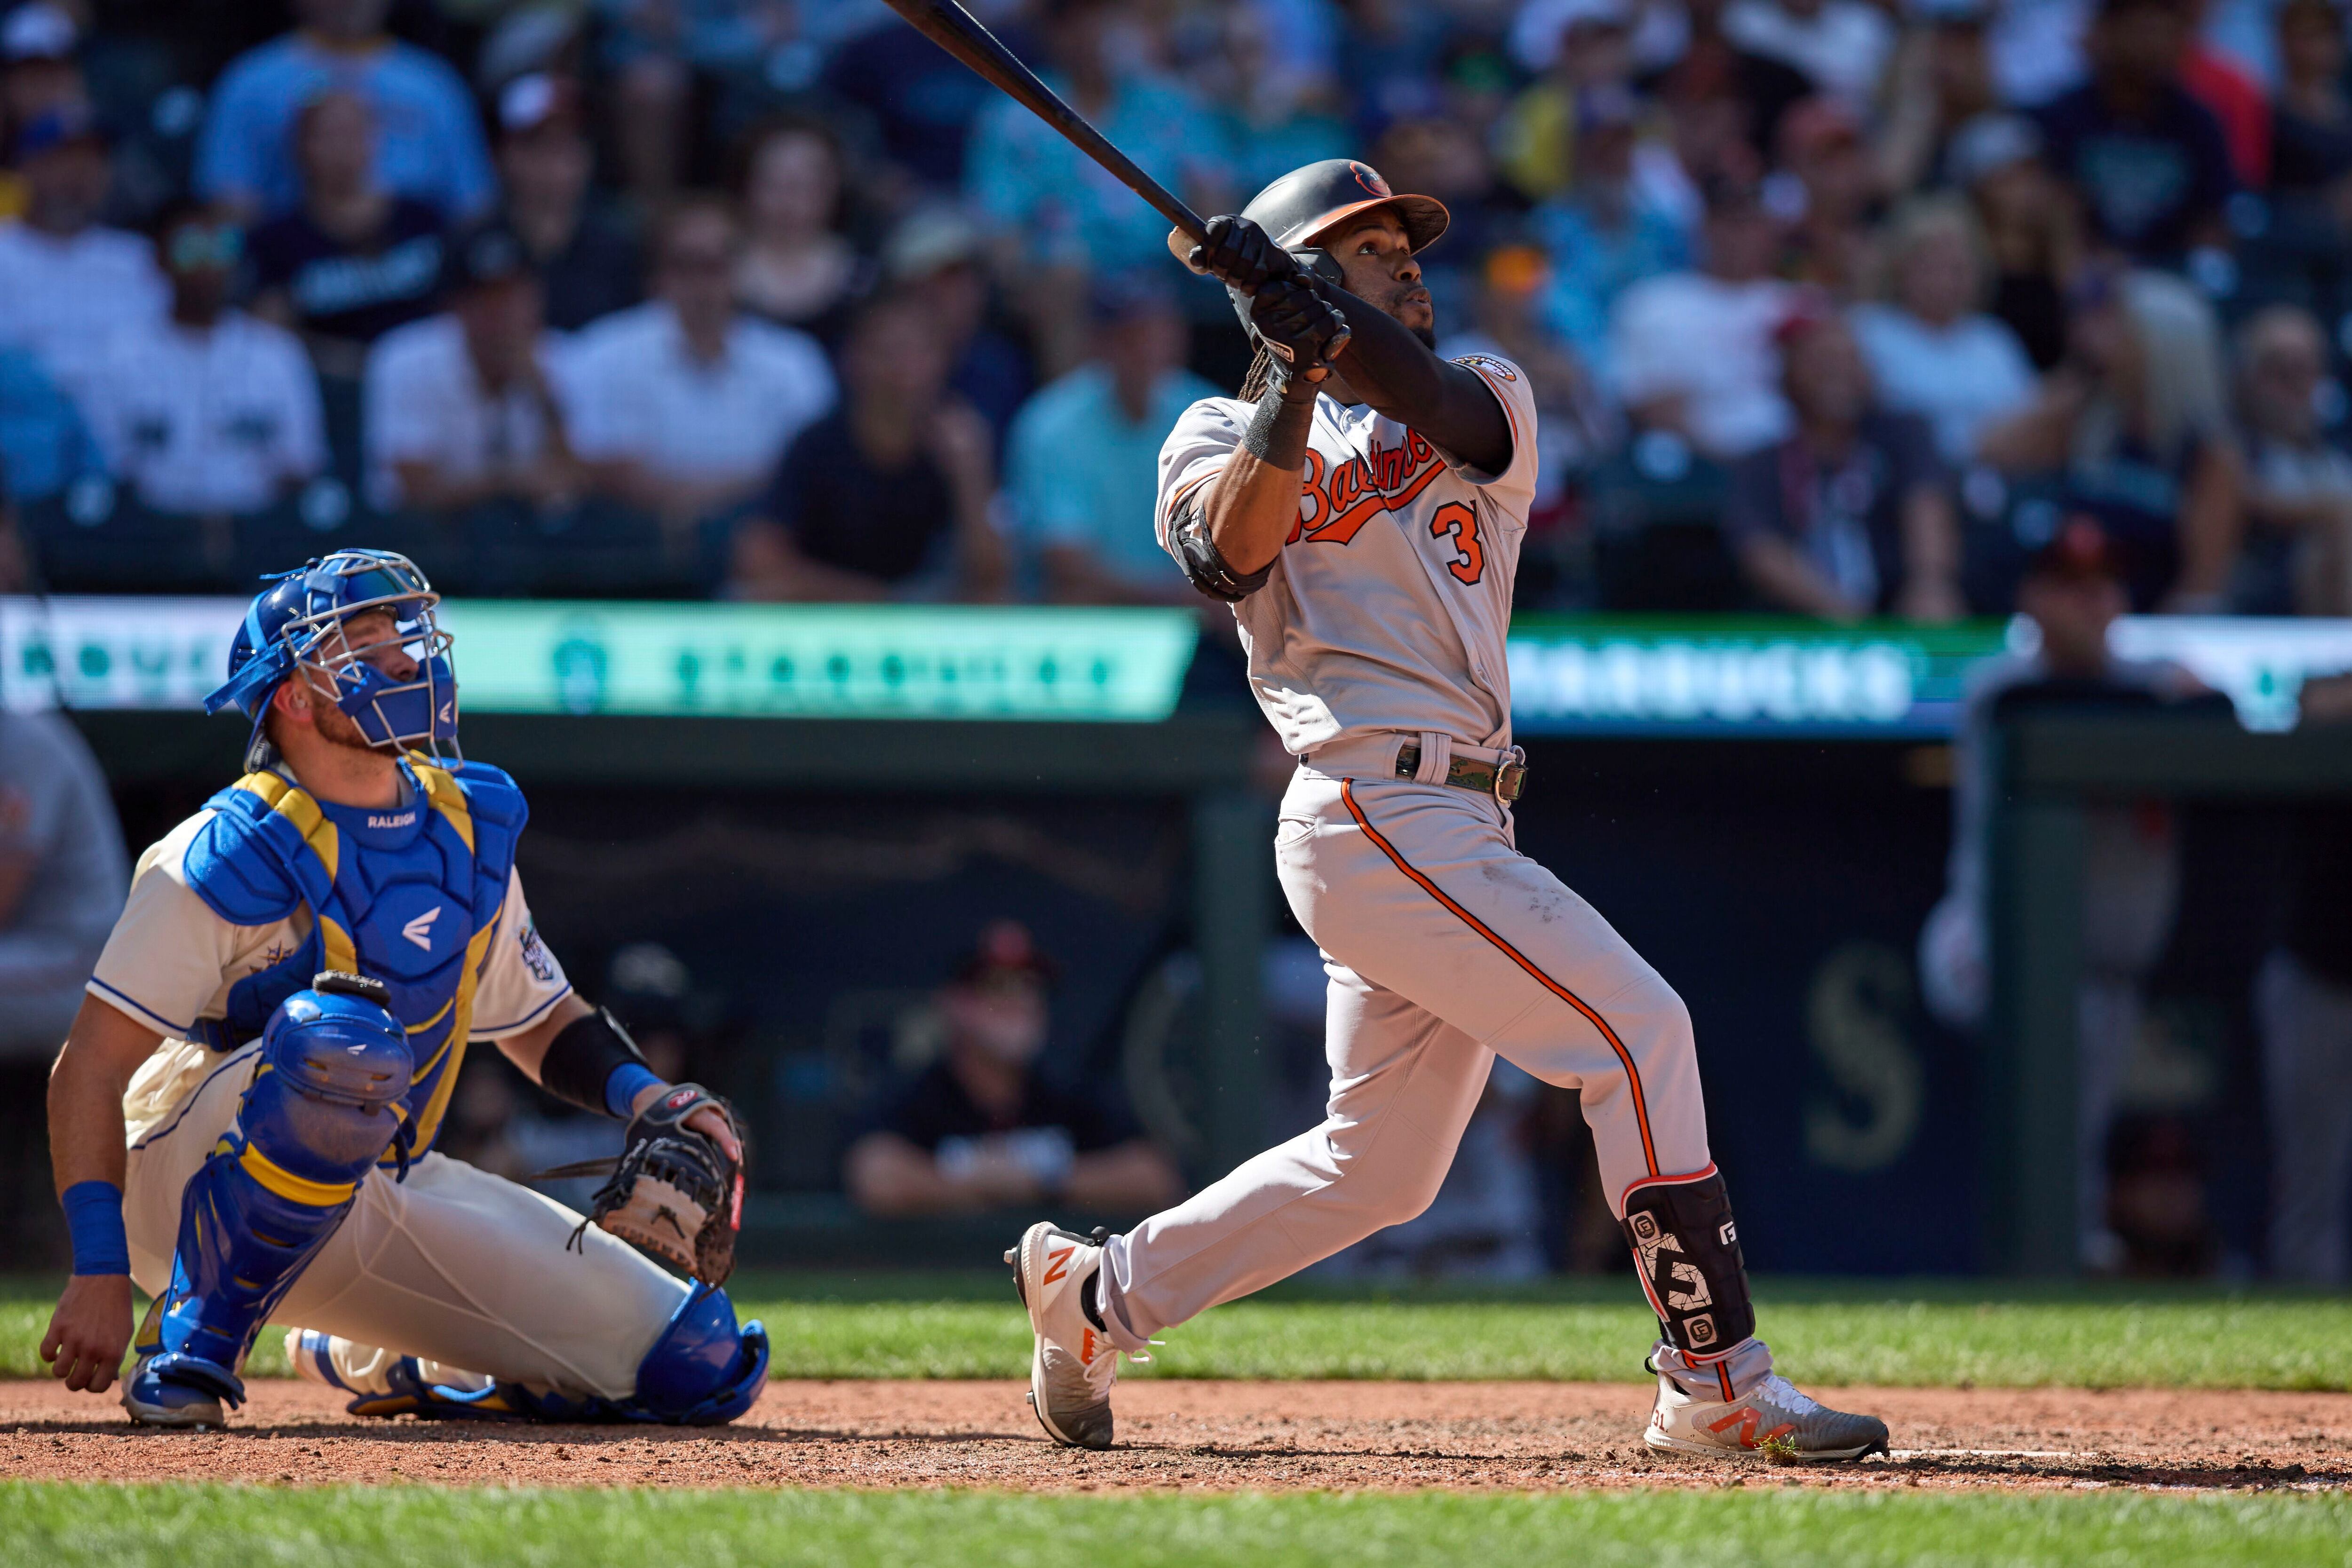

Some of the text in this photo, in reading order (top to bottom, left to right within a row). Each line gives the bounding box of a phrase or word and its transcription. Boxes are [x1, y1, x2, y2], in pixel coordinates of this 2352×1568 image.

[1453, 356, 1515, 376] ALTIMORE
[1286, 428, 1435, 546] Baltimo
[1429, 500, 1485, 586] 3
[367, 811, 416, 828] RALEIGH
[1653, 1409, 1665, 1432] 31
